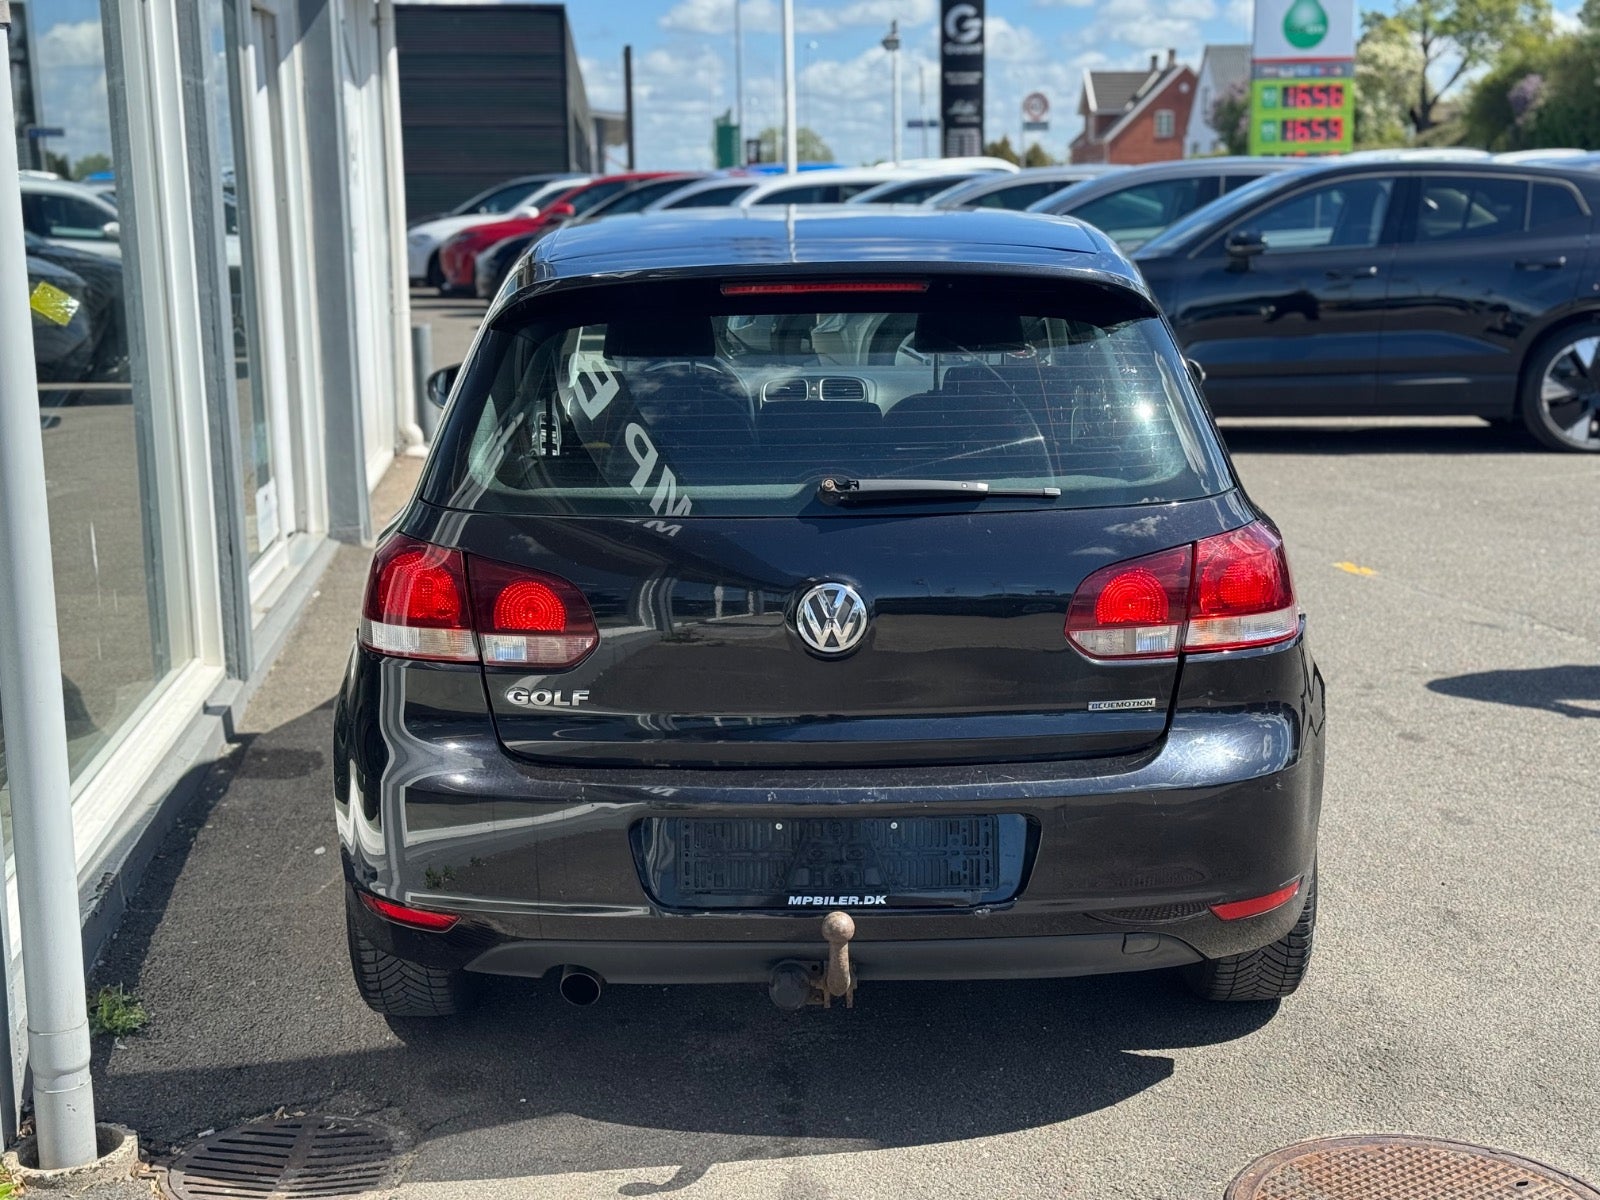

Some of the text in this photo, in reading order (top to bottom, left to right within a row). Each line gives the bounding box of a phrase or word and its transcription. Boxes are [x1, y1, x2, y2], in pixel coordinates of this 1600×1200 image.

[798, 583, 867, 652] VW
[506, 687, 590, 706] GOLF
[1091, 699, 1153, 710] BLUEMOTION
[787, 895, 887, 905] MPBILER.DK
